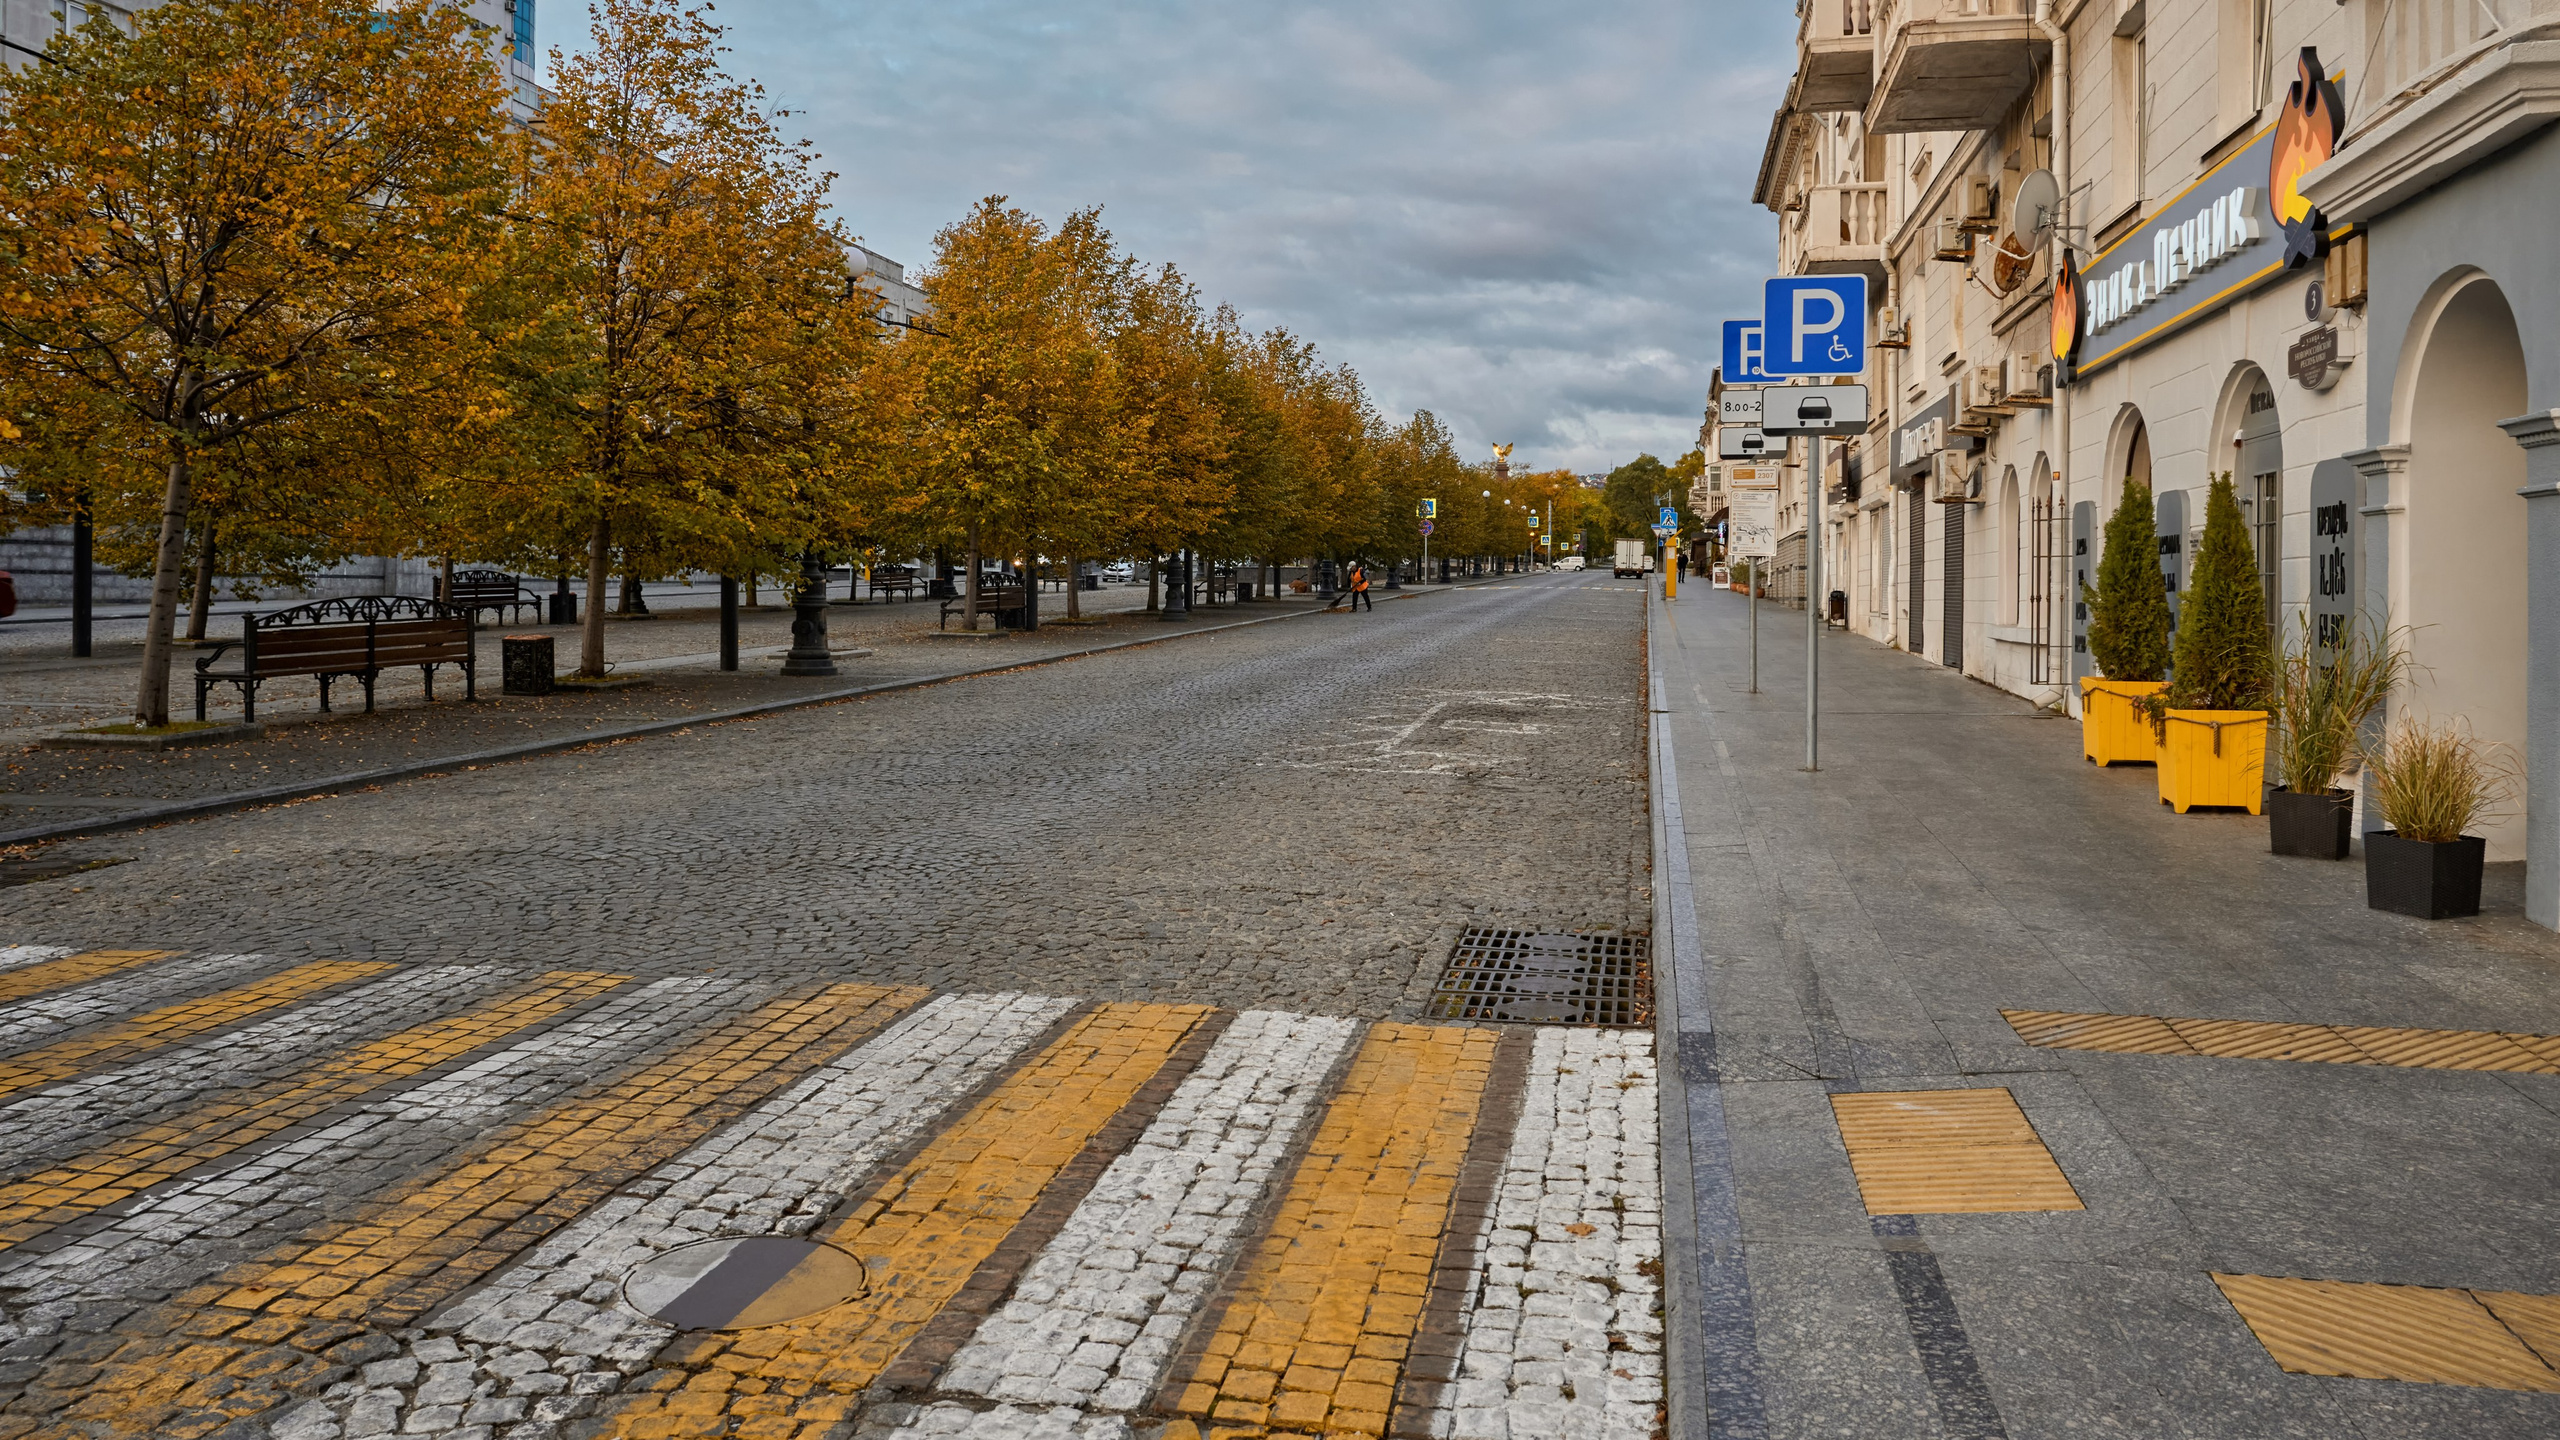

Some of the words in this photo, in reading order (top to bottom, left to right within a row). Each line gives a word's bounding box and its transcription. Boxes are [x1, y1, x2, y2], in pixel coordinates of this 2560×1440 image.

[2154, 187, 2250, 295] ПЕЧНИК
[1792, 288, 1845, 363] P
[2319, 546, 2346, 601] ХЛЕБ
